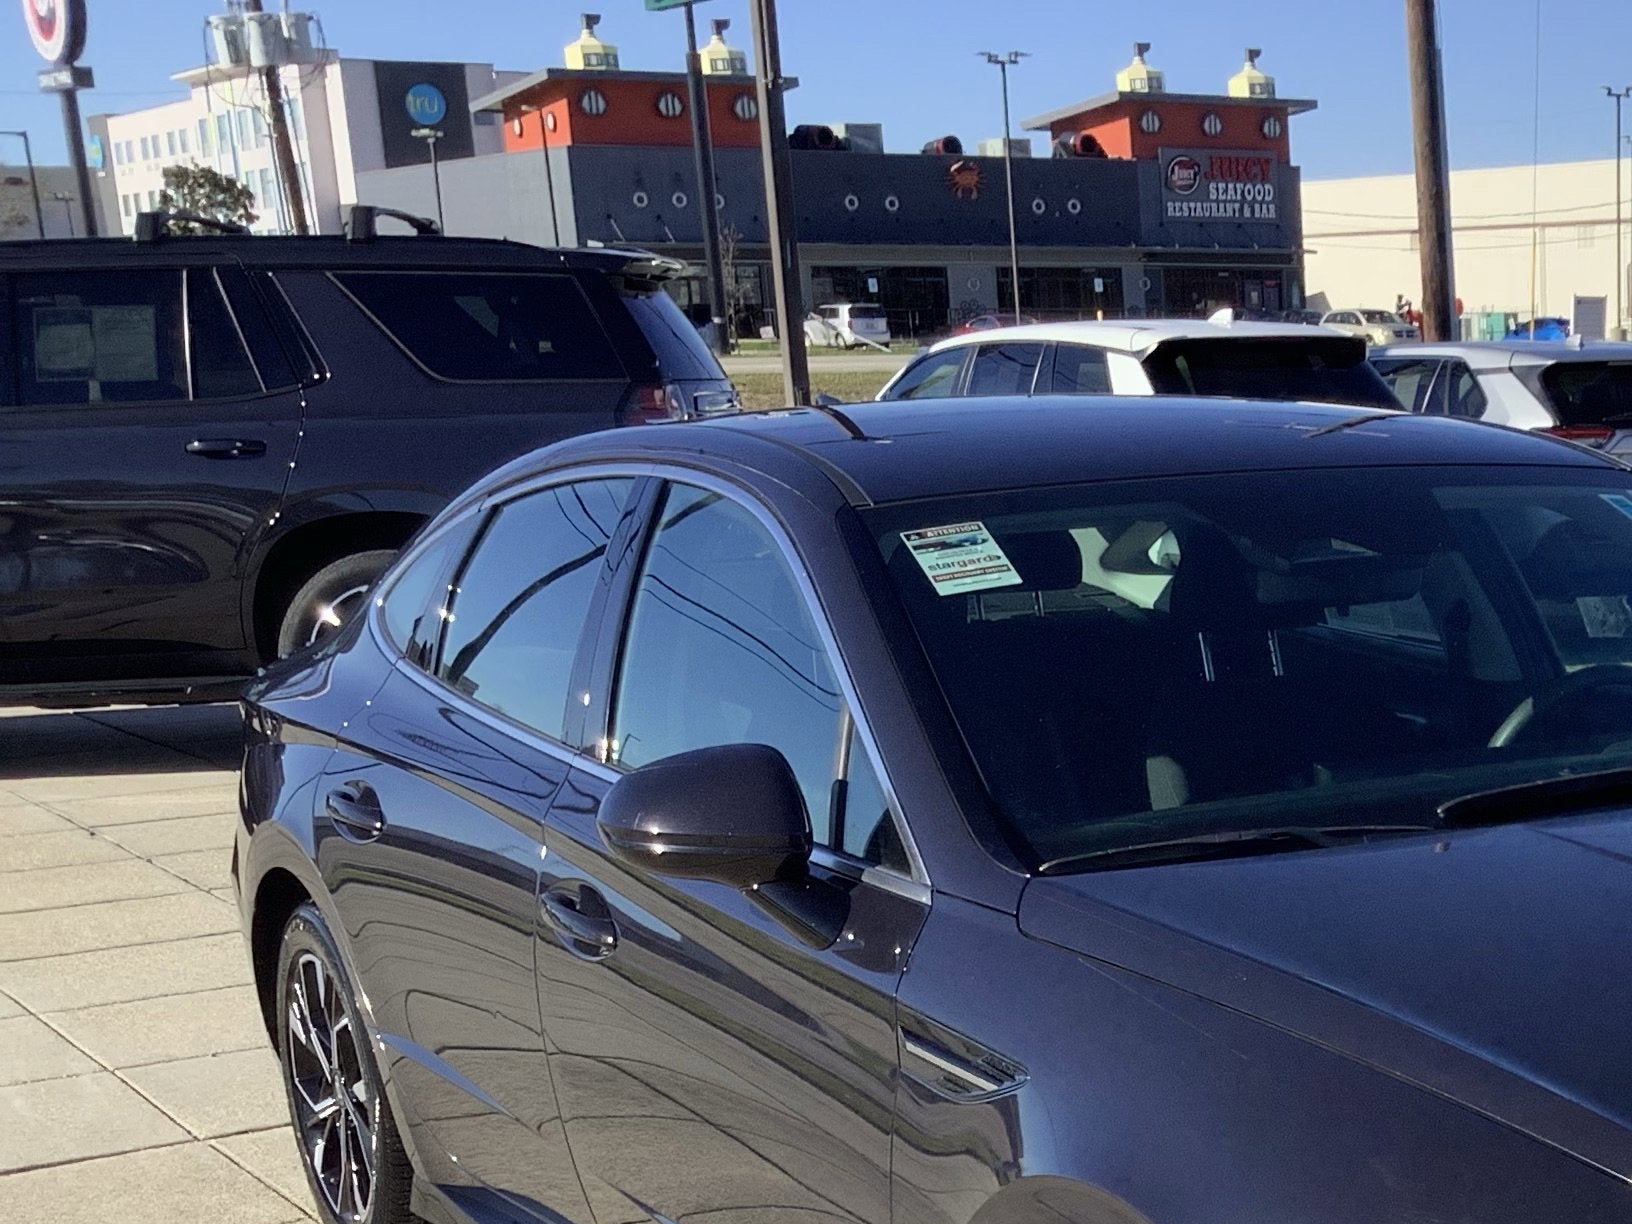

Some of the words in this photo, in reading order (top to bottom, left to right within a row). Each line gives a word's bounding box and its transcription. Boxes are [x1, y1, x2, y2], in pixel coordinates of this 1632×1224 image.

[1204, 157, 1272, 181] JUICY
[1209, 182, 1274, 201] SEAFOOD
[1167, 202, 1240, 218] RESTAURANT
[1243, 203, 1251, 217] &
[1254, 204, 1276, 218] BAR
[927, 524, 979, 538] ATTENTION
[927, 554, 995, 572] stargard
